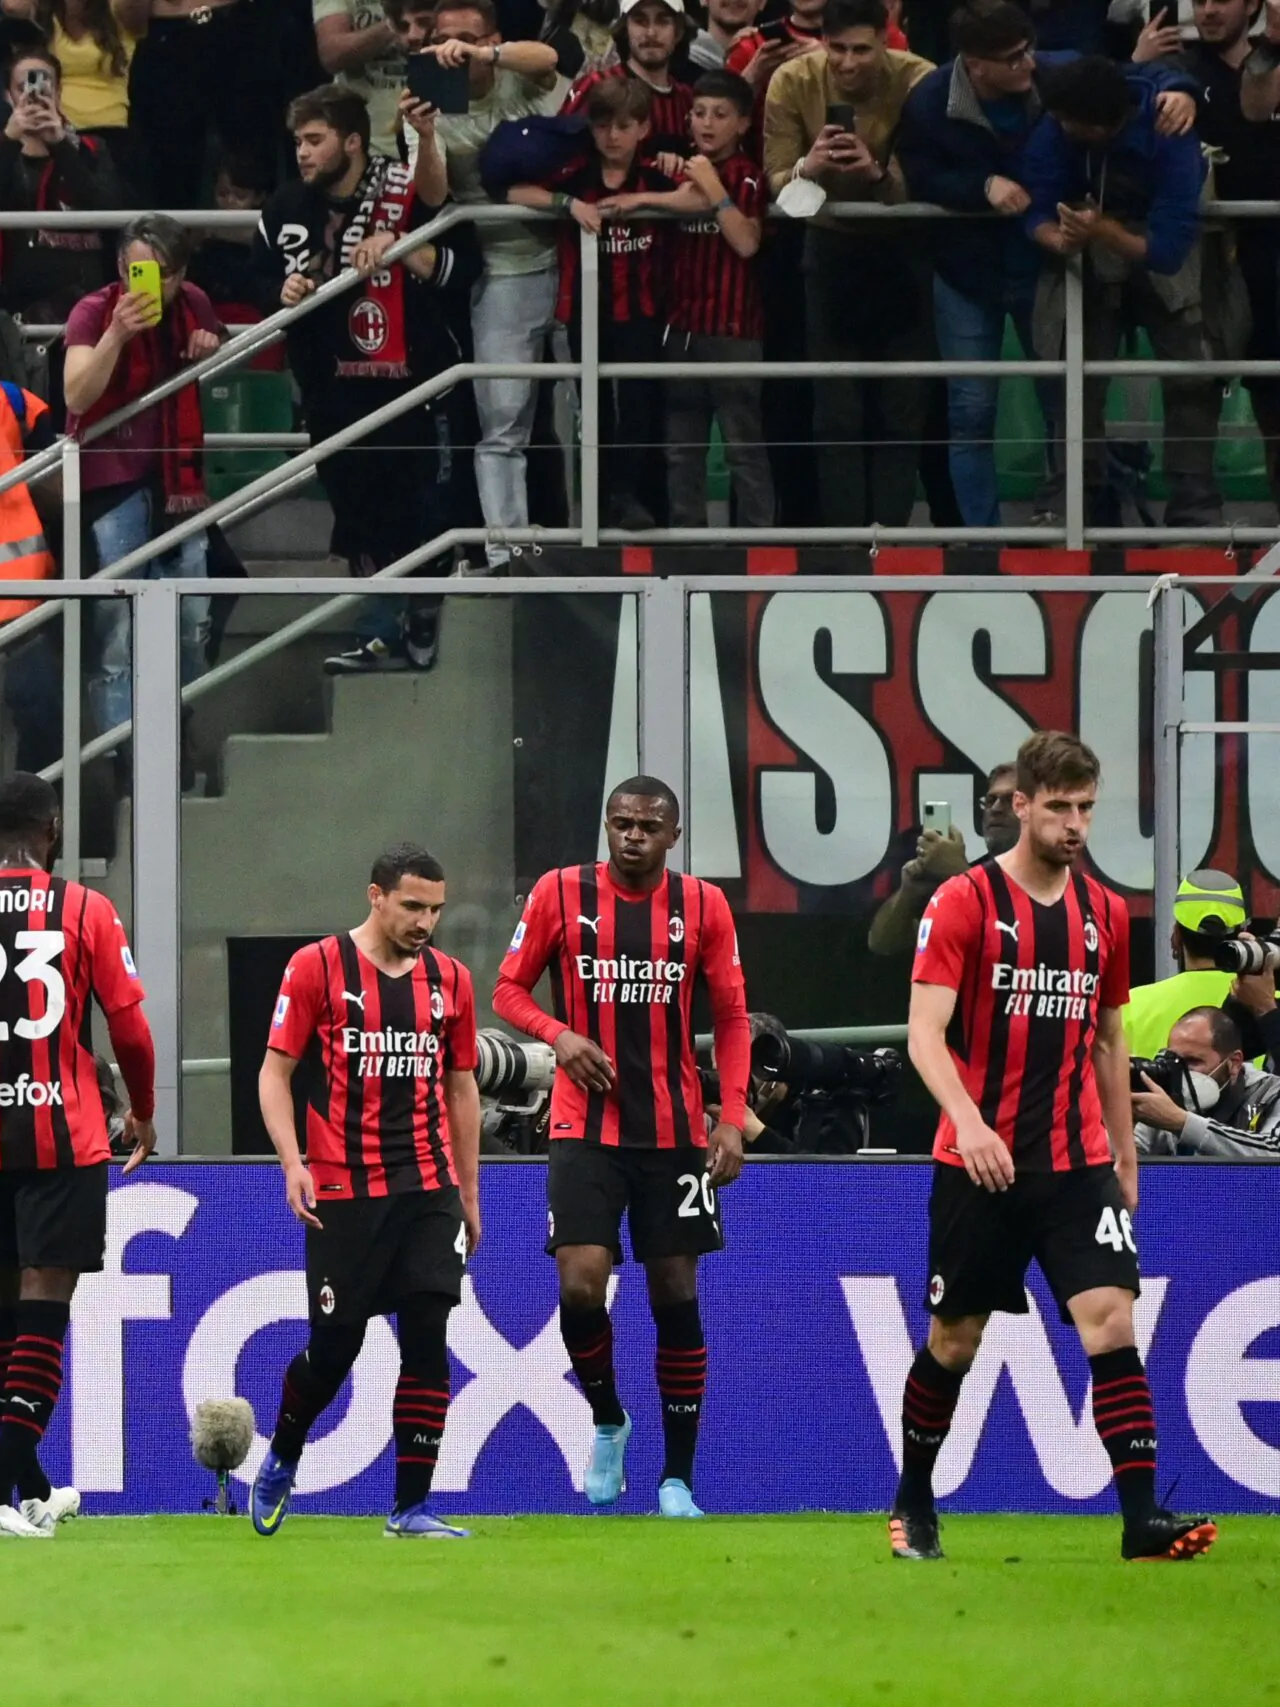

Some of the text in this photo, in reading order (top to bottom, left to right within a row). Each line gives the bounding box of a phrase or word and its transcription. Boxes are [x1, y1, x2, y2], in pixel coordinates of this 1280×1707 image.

[372, 201, 405, 288] Pae
[600, 234, 653, 253] mirates
[574, 953, 688, 982] Emirates
[593, 982, 673, 1004] FLY BETTER
[1004, 993, 1087, 1020] FLY BETTER
[357, 1056, 433, 1078] FLY BETTER
[676, 1172, 716, 1218] 20
[667, 1403, 698, 1414] ACM
[1129, 1438, 1158, 1449] ACM
